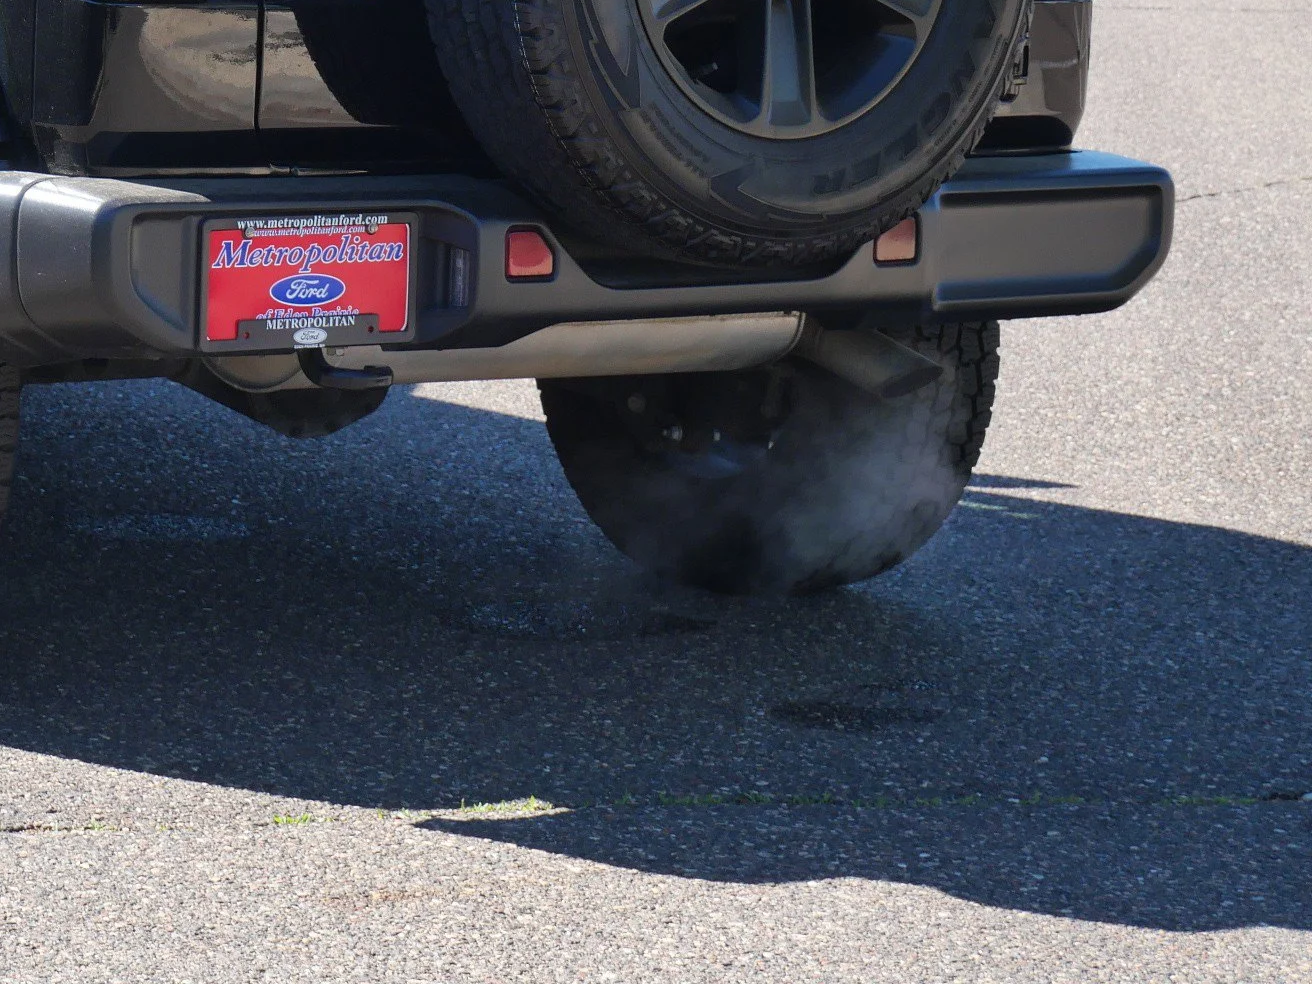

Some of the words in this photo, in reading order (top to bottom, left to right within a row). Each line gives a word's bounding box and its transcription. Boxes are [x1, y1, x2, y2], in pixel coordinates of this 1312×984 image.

[237, 214, 388, 230] www.metropolitanford.com
[212, 234, 404, 273] Metropolitan
[286, 279, 330, 299] Ford
[266, 315, 356, 330] METROPOLITAN
